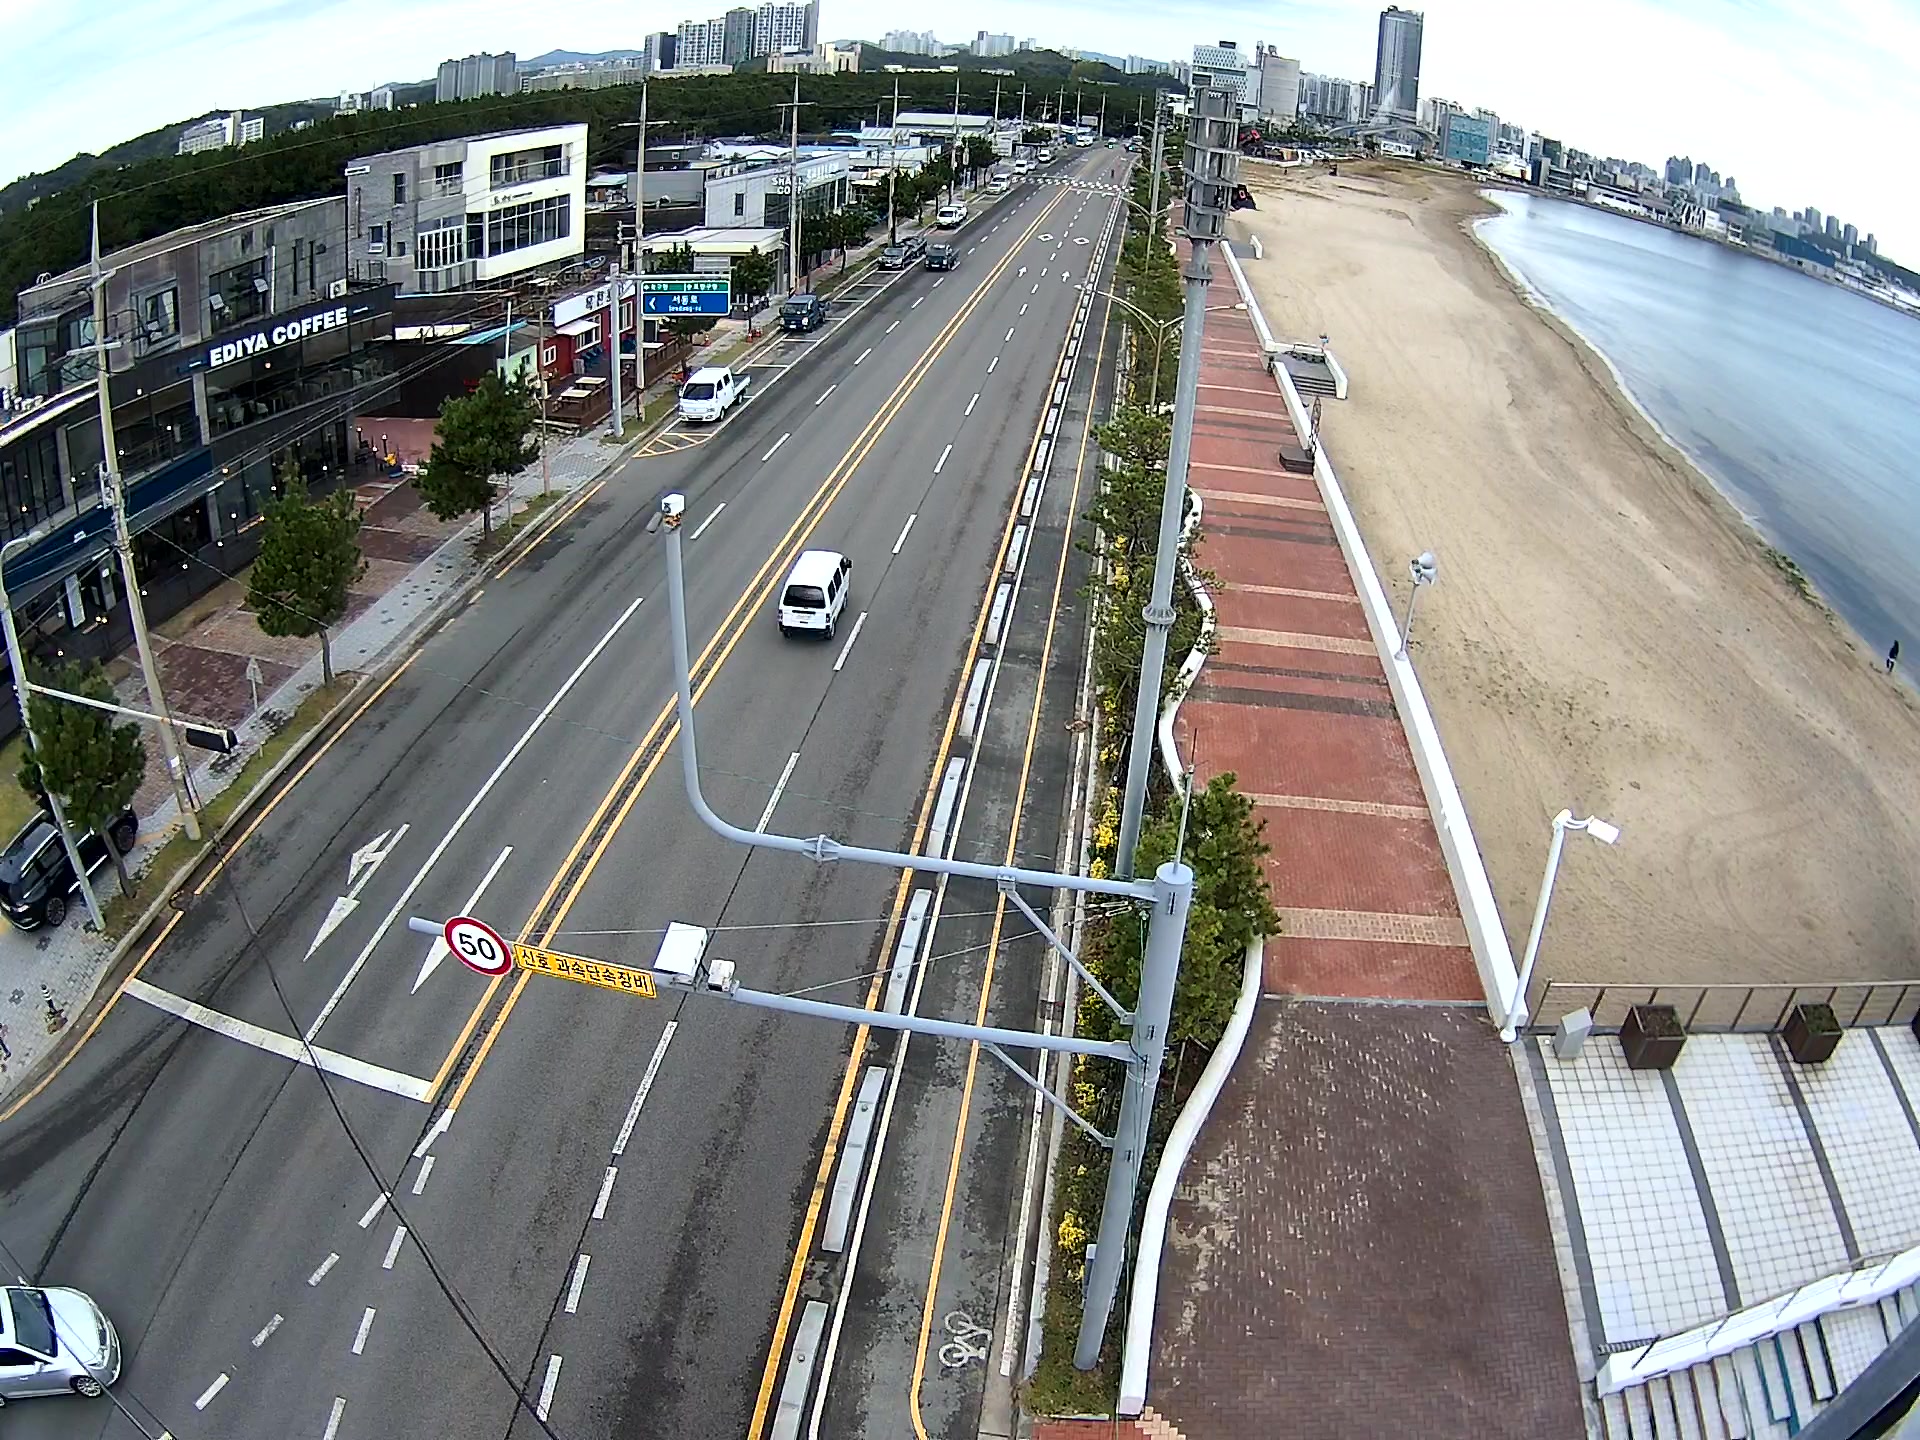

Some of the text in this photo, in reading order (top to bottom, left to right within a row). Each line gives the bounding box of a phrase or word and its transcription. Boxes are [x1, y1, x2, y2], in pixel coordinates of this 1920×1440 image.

[209, 307, 348, 367] EDIYA COFFEE
[459, 932, 496, 960] 50
[522, 949, 649, 992] 신호 과속단속장비
